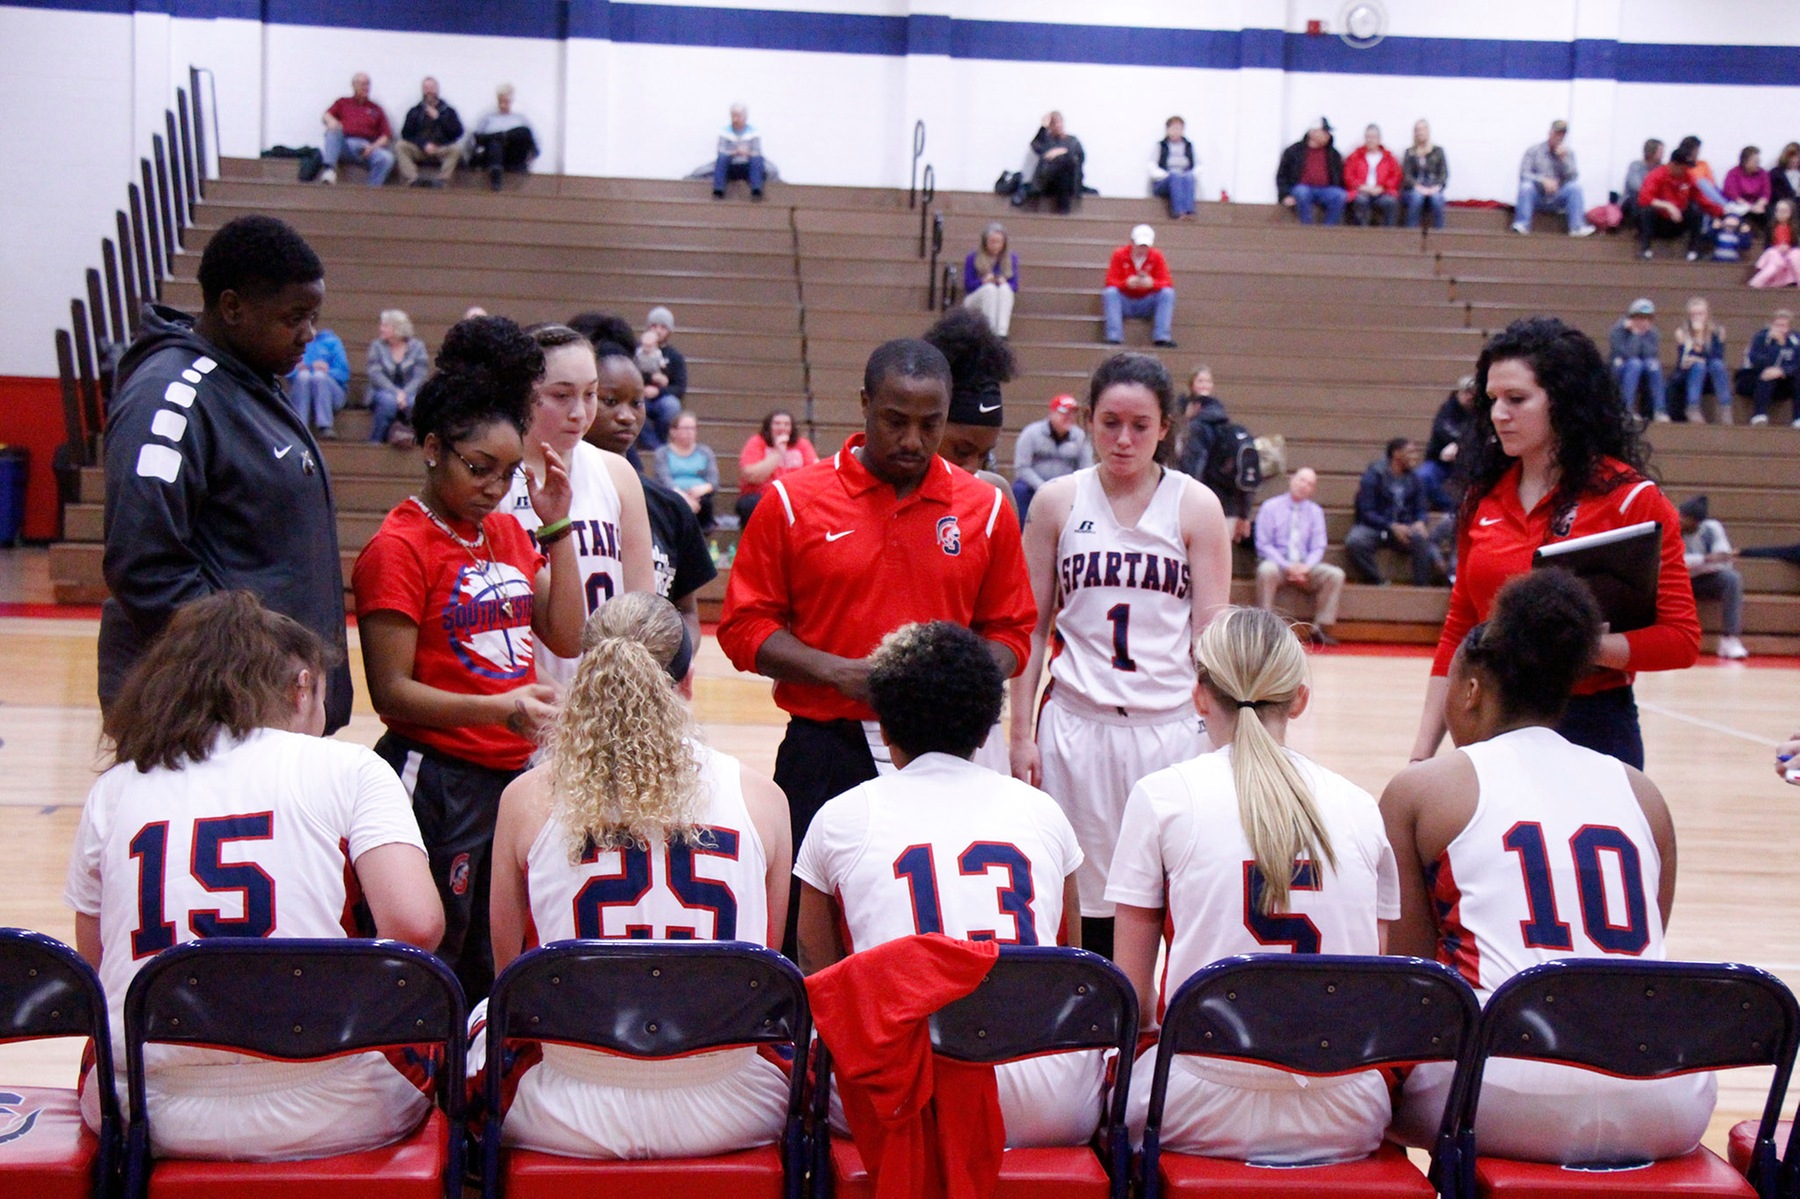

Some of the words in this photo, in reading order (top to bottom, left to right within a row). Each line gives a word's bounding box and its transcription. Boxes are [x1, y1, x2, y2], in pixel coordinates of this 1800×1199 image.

[1062, 551, 1191, 599] SPARTANS
[1106, 602, 1137, 673] 1
[129, 810, 276, 961] 15
[572, 823, 740, 940] 25
[892, 840, 1039, 946] 13
[1242, 859, 1324, 954] 5
[1502, 820, 1651, 957] 10
